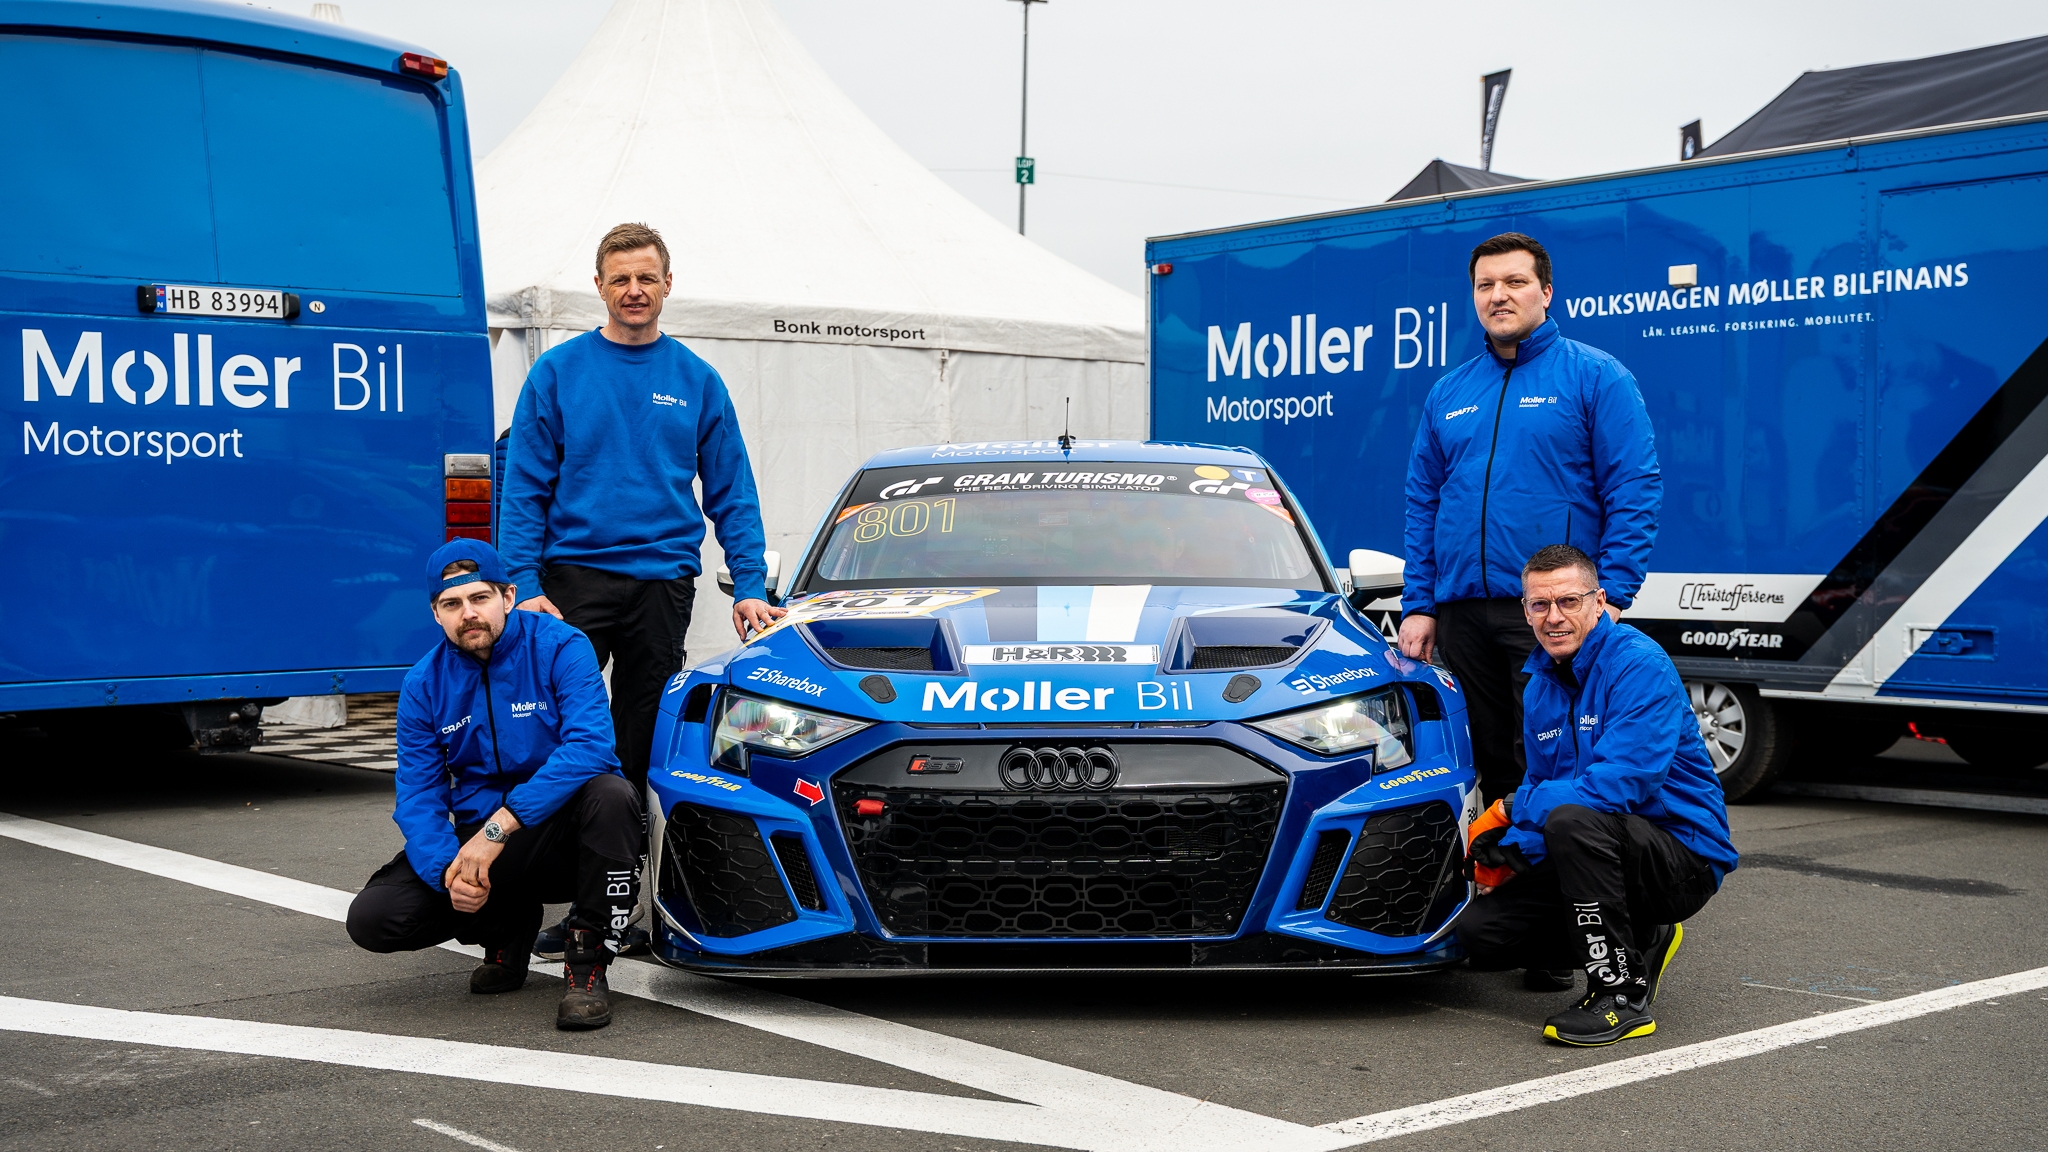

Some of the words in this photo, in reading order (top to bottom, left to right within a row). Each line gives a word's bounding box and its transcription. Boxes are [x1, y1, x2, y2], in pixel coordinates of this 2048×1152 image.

[1020, 169, 1029, 183] 2
[171, 289, 201, 310] HB
[212, 291, 279, 314] 83994
[1566, 286, 1720, 319] VOLKSWAGEN
[1728, 275, 1825, 308] MØLLER
[1834, 263, 1969, 297] BILFINANS
[774, 319, 821, 335] Bonk
[827, 323, 926, 342] motorsport
[1394, 302, 1448, 370] Bil
[1642, 326, 1666, 338] LÅN.
[1670, 323, 1720, 336] LEASING.
[1724, 318, 1799, 332] FORSIKRING.
[1804, 312, 1875, 327] MOBILITET.
[332, 342, 403, 412] Bil
[1206, 391, 1334, 425] Motorsport
[1548, 396, 1558, 404] Bil
[1445, 406, 1473, 420] CRAFT
[24, 421, 243, 465] Motorsport
[953, 472, 1035, 487] GRAN
[1082, 484, 1161, 492] SIMULATOR
[1237, 469, 1257, 482] T
[853, 497, 957, 543] 801
[797, 595, 934, 613] 801
[1681, 628, 1784, 651] GOODYEAR
[763, 668, 827, 698] Sharebox
[1310, 666, 1380, 691] Sharebox
[1136, 680, 1193, 711] Bil
[441, 715, 472, 735] CRAFT
[1537, 729, 1558, 742] CRAFT
[671, 769, 743, 792] GOODYEAR
[1379, 766, 1451, 791] GOODYEAR
[606, 870, 631, 897] Bil
[1573, 901, 1603, 926] Bil
